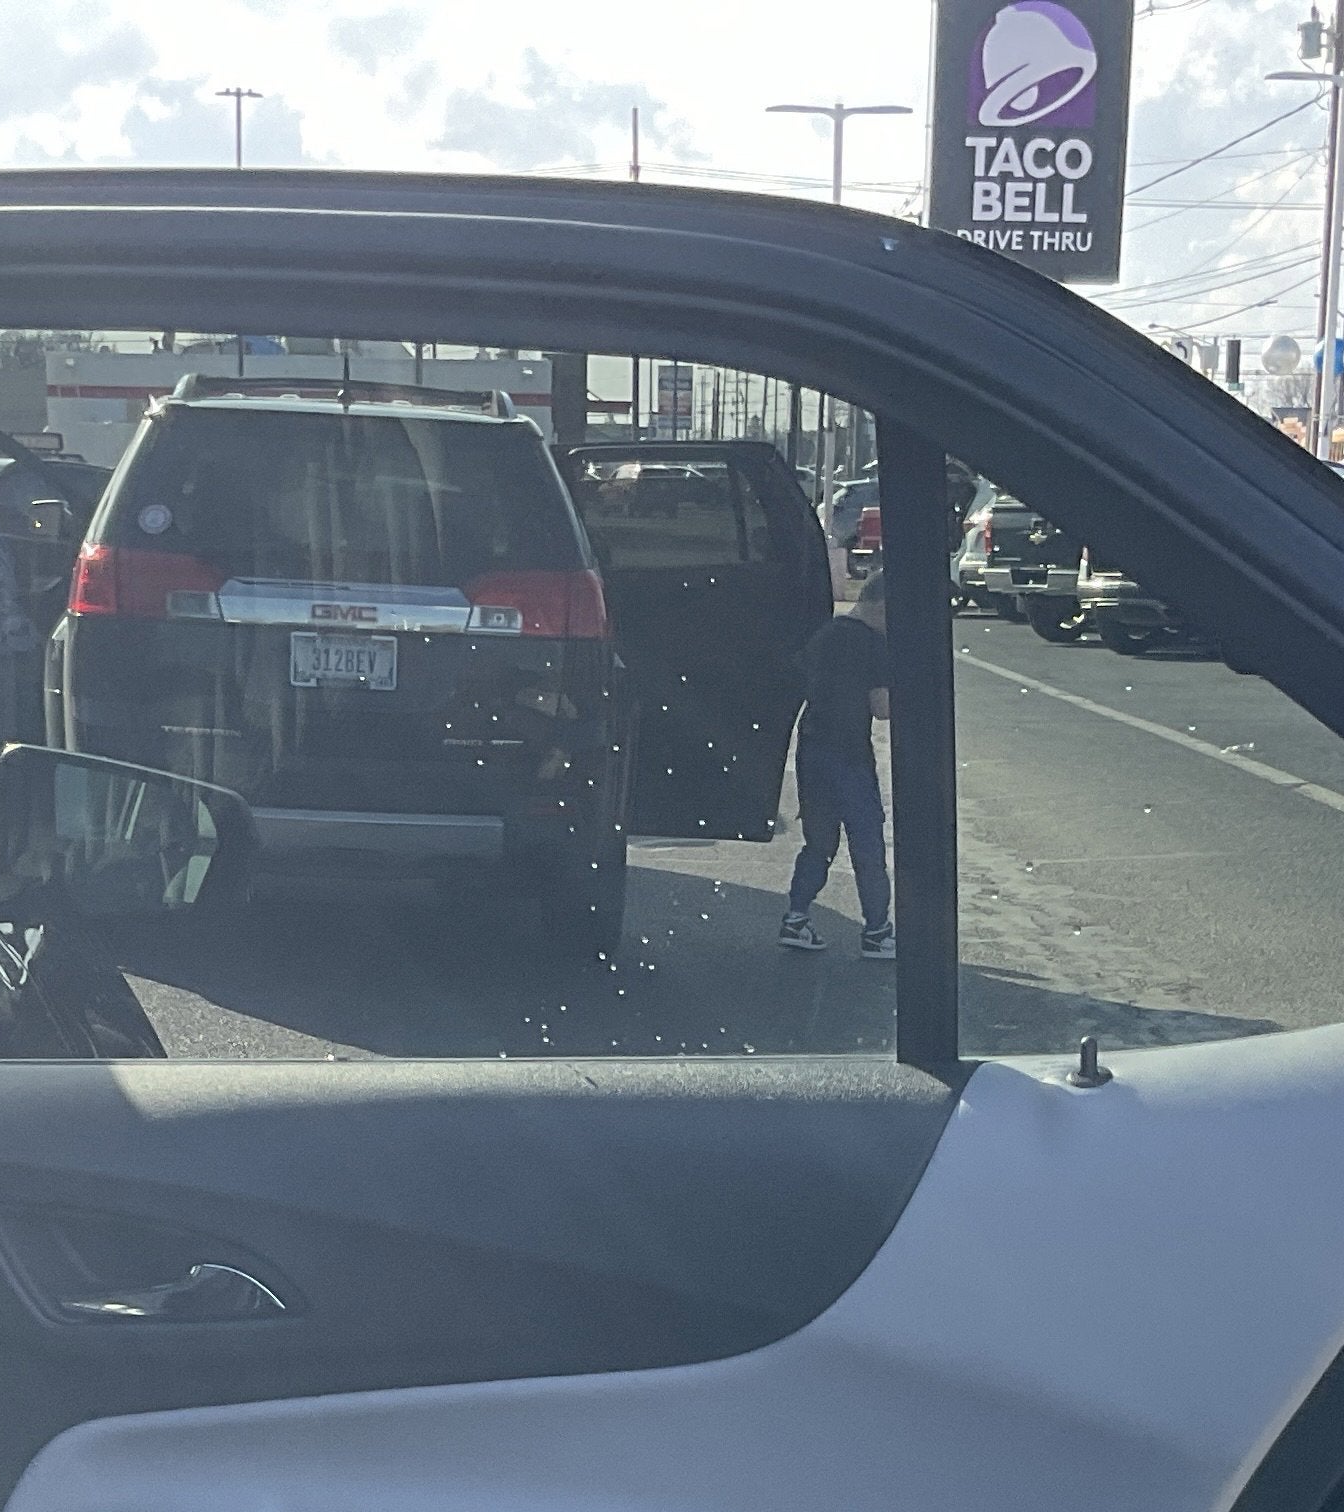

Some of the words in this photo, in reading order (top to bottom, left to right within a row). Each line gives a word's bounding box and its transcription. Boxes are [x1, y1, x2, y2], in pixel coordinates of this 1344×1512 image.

[964, 136, 1093, 180] TACO
[971, 181, 1088, 223] BELL
[1030, 230, 1093, 252] THRU
[311, 603, 378, 622] GMC
